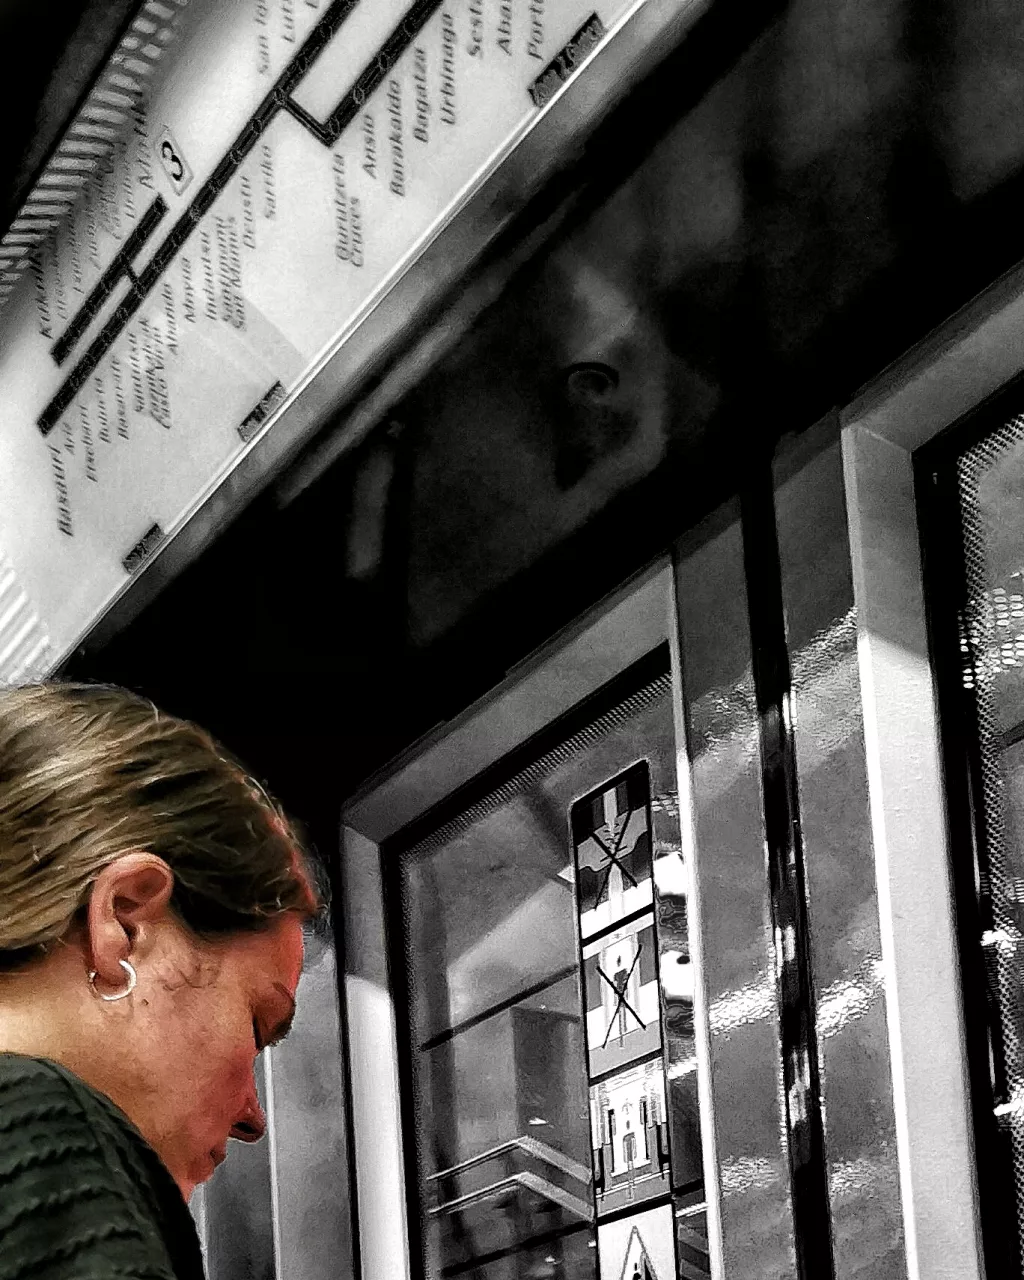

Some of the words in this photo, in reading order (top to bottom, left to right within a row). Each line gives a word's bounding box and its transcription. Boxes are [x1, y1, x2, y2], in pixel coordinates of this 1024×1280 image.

[280, 0, 296, 43] Lut
[495, 0, 512, 56] Aba
[412, 47, 429, 143] Bagatza
[439, 13, 456, 126] Urbinaga
[161, 140, 184, 182] 3
[362, 114, 376, 180] Ansio
[386, 80, 405, 196] Barakaldo
[240, 175, 256, 250] Deustu
[260, 145, 276, 220] Sarriko
[349, 197, 365, 269] Cruces
[163, 282, 179, 356] Abando
[47, 444, 74, 537] Basauri
